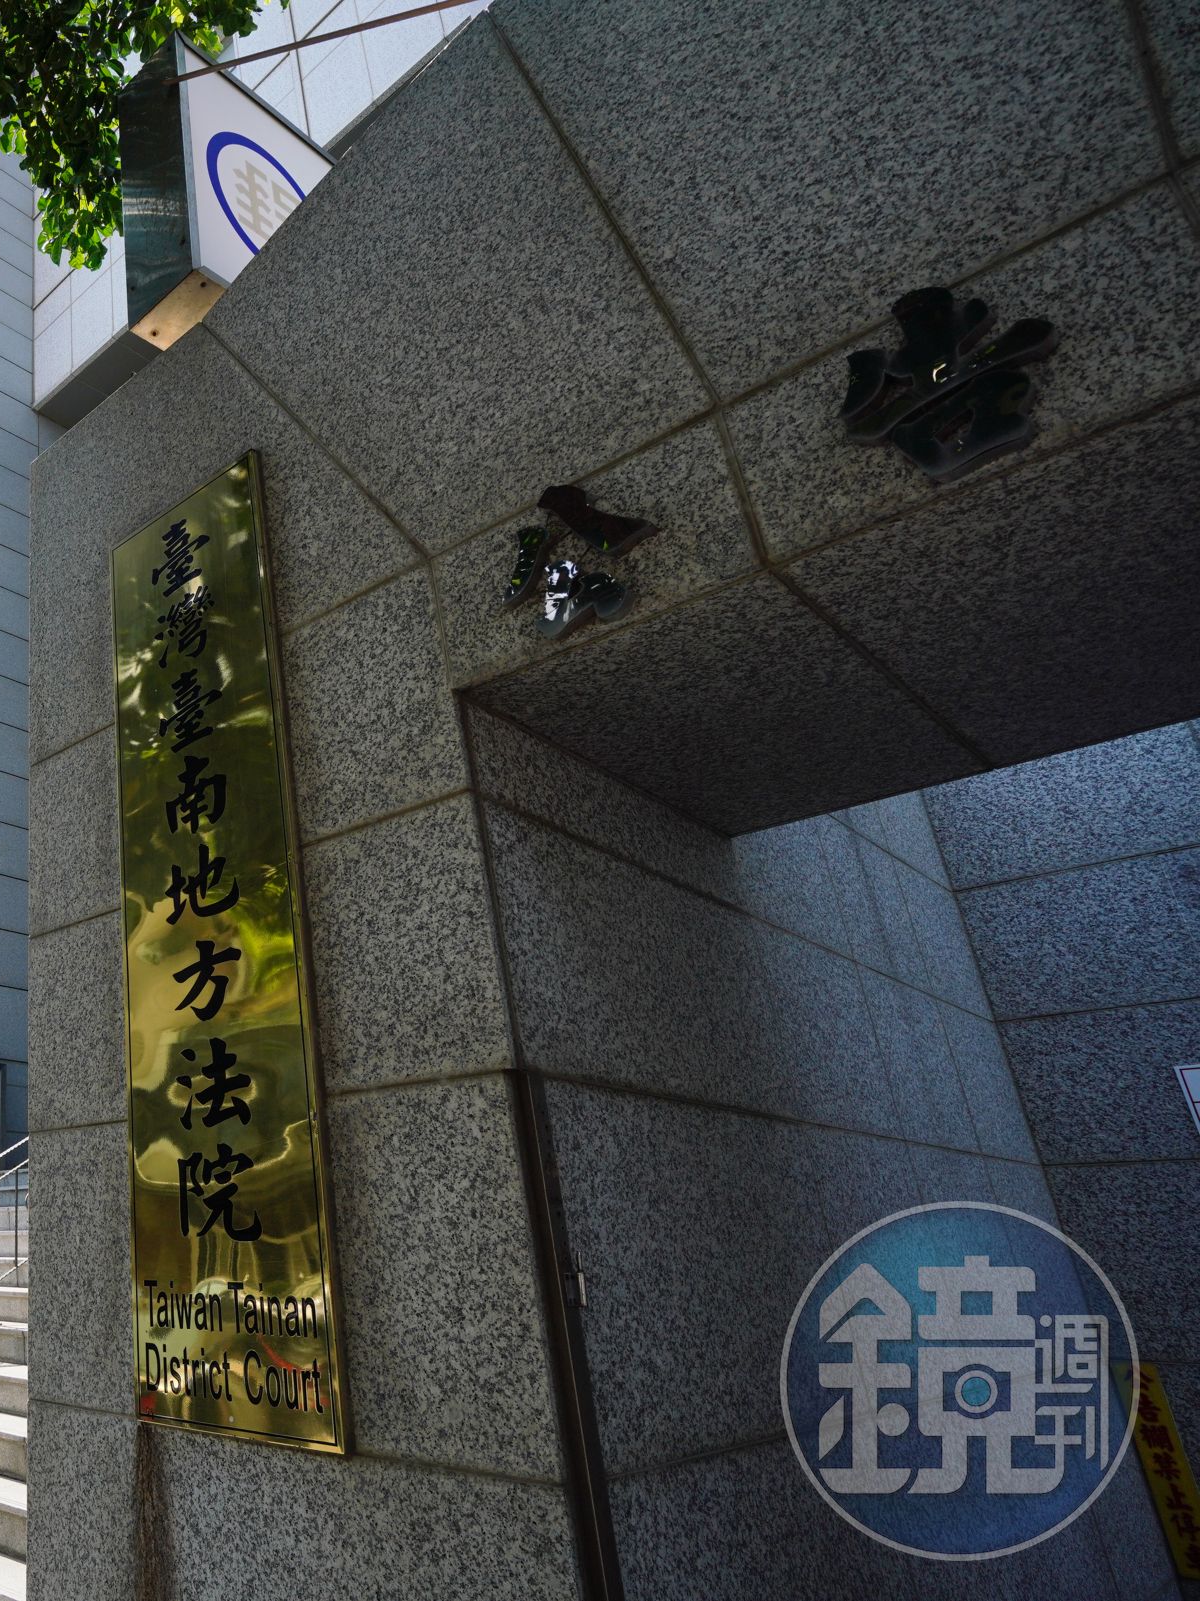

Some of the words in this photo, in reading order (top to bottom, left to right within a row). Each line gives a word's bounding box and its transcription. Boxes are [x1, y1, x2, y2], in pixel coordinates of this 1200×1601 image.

[151, 518, 263, 1243] 臺灣臺南地方法院
[143, 1279, 224, 1333] Taiwan
[227, 1281, 319, 1339] Tainan
[144, 1341, 233, 1402] District
[243, 1349, 325, 1415] Court
